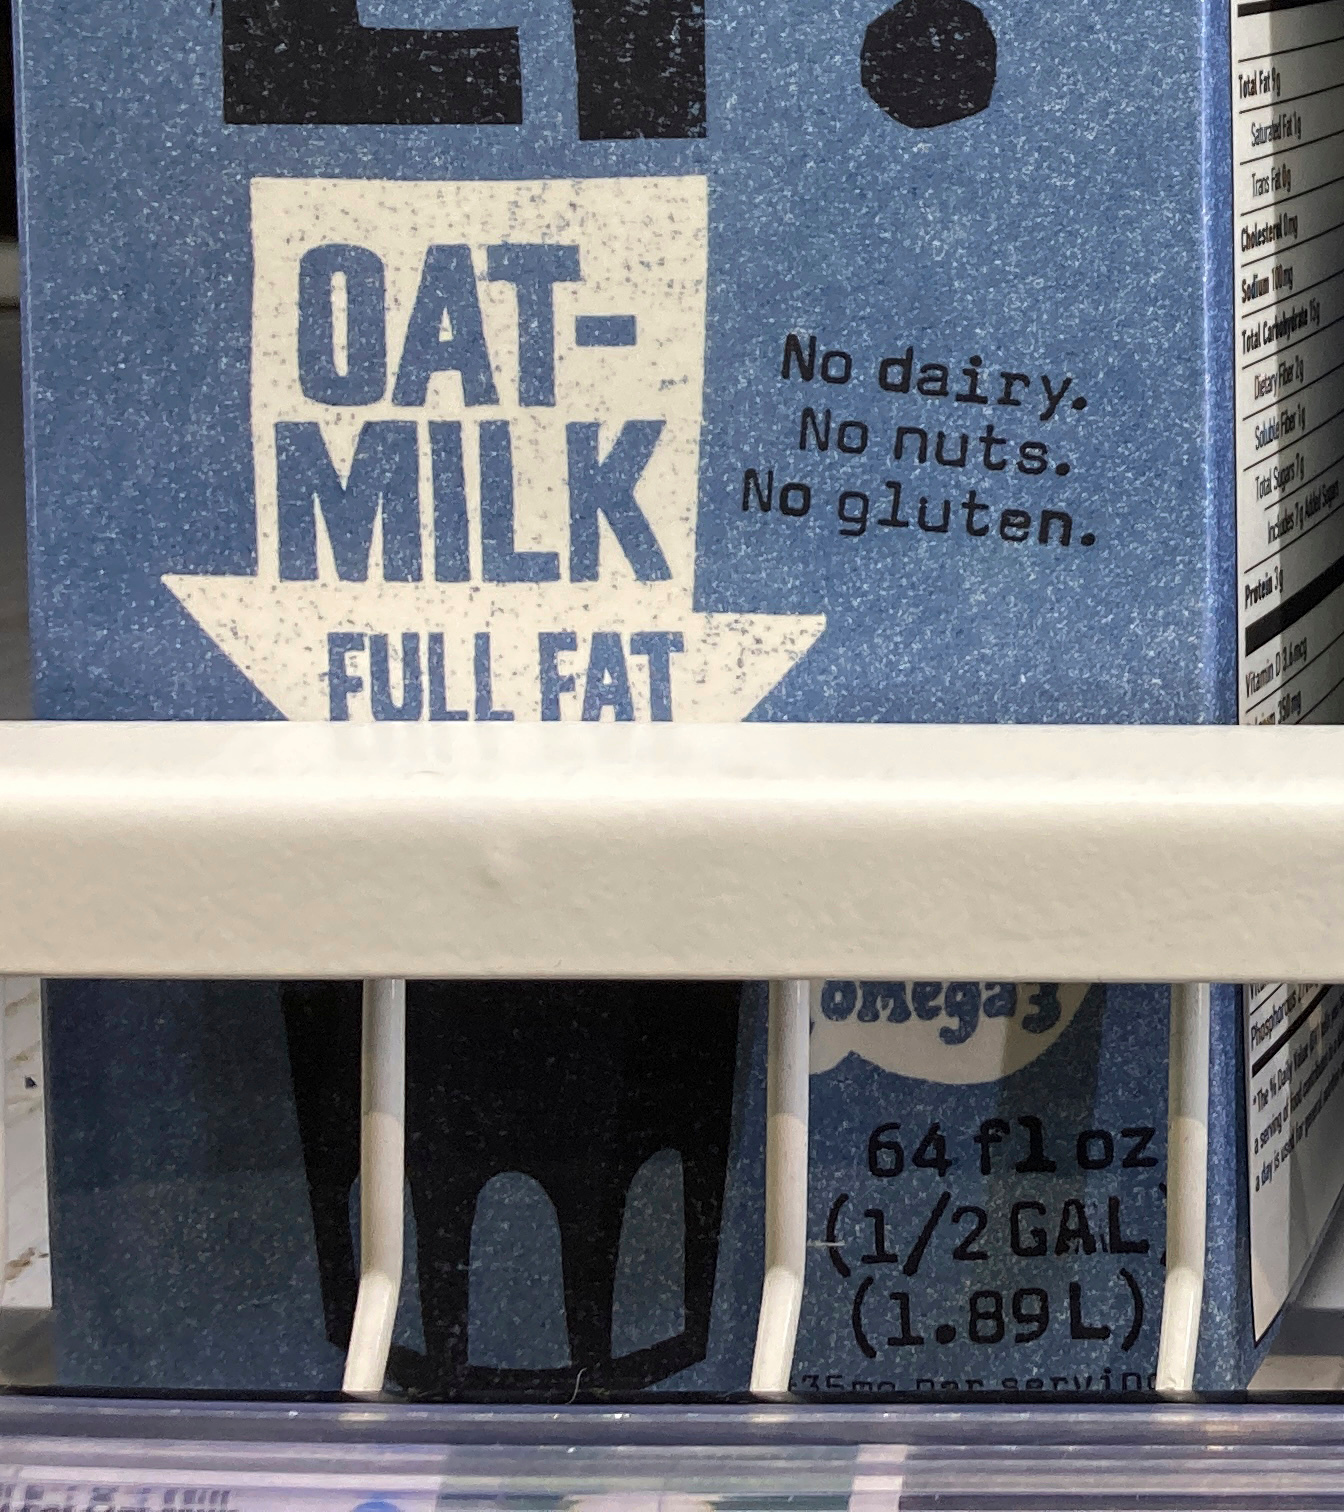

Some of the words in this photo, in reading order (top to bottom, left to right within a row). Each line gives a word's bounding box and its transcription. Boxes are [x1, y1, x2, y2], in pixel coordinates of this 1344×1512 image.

[1239, 70, 1258, 99] Total
[1259, 70, 1271, 94] Fat
[1251, 113, 1282, 146] Saturated
[1282, 113, 1293, 138] Fat
[1252, 172, 1270, 198] Trans
[1271, 167, 1281, 192] Fat
[1241, 214, 1283, 252] Cholesterol
[1241, 273, 1270, 303] Sodium
[299, 243, 638, 407] OAT-
[1242, 326, 1262, 355] Total
[1263, 305, 1308, 345] Carbohydrate
[781, 333, 852, 384] No
[878, 346, 1088, 421] dairy.
[1254, 370, 1278, 400] Dietary
[1278, 360, 1294, 388] Fiber
[799, 406, 868, 454] No
[894, 424, 1070, 476] nuts.
[1280, 409, 1296, 438] Fiber
[275, 419, 673, 583] MILK
[1255, 474, 1272, 502] Total
[1273, 462, 1295, 492] Sugars
[742, 468, 811, 517] No
[838, 480, 1096, 547] gluten.
[1245, 571, 1273, 609] Protein
[326, 631, 514, 721] FULL
[538, 631, 684, 721] FAT
[1245, 658, 1274, 698] Vitamin
[868, 1122, 953, 1178] 64
[974, 1116, 1057, 1176] fl
[1075, 1127, 1158, 1171] oz
[1260, 1113, 1282, 1149] serving
[1261, 1160, 1273, 1187] day
[826, 1191, 988, 1278] (1/2
